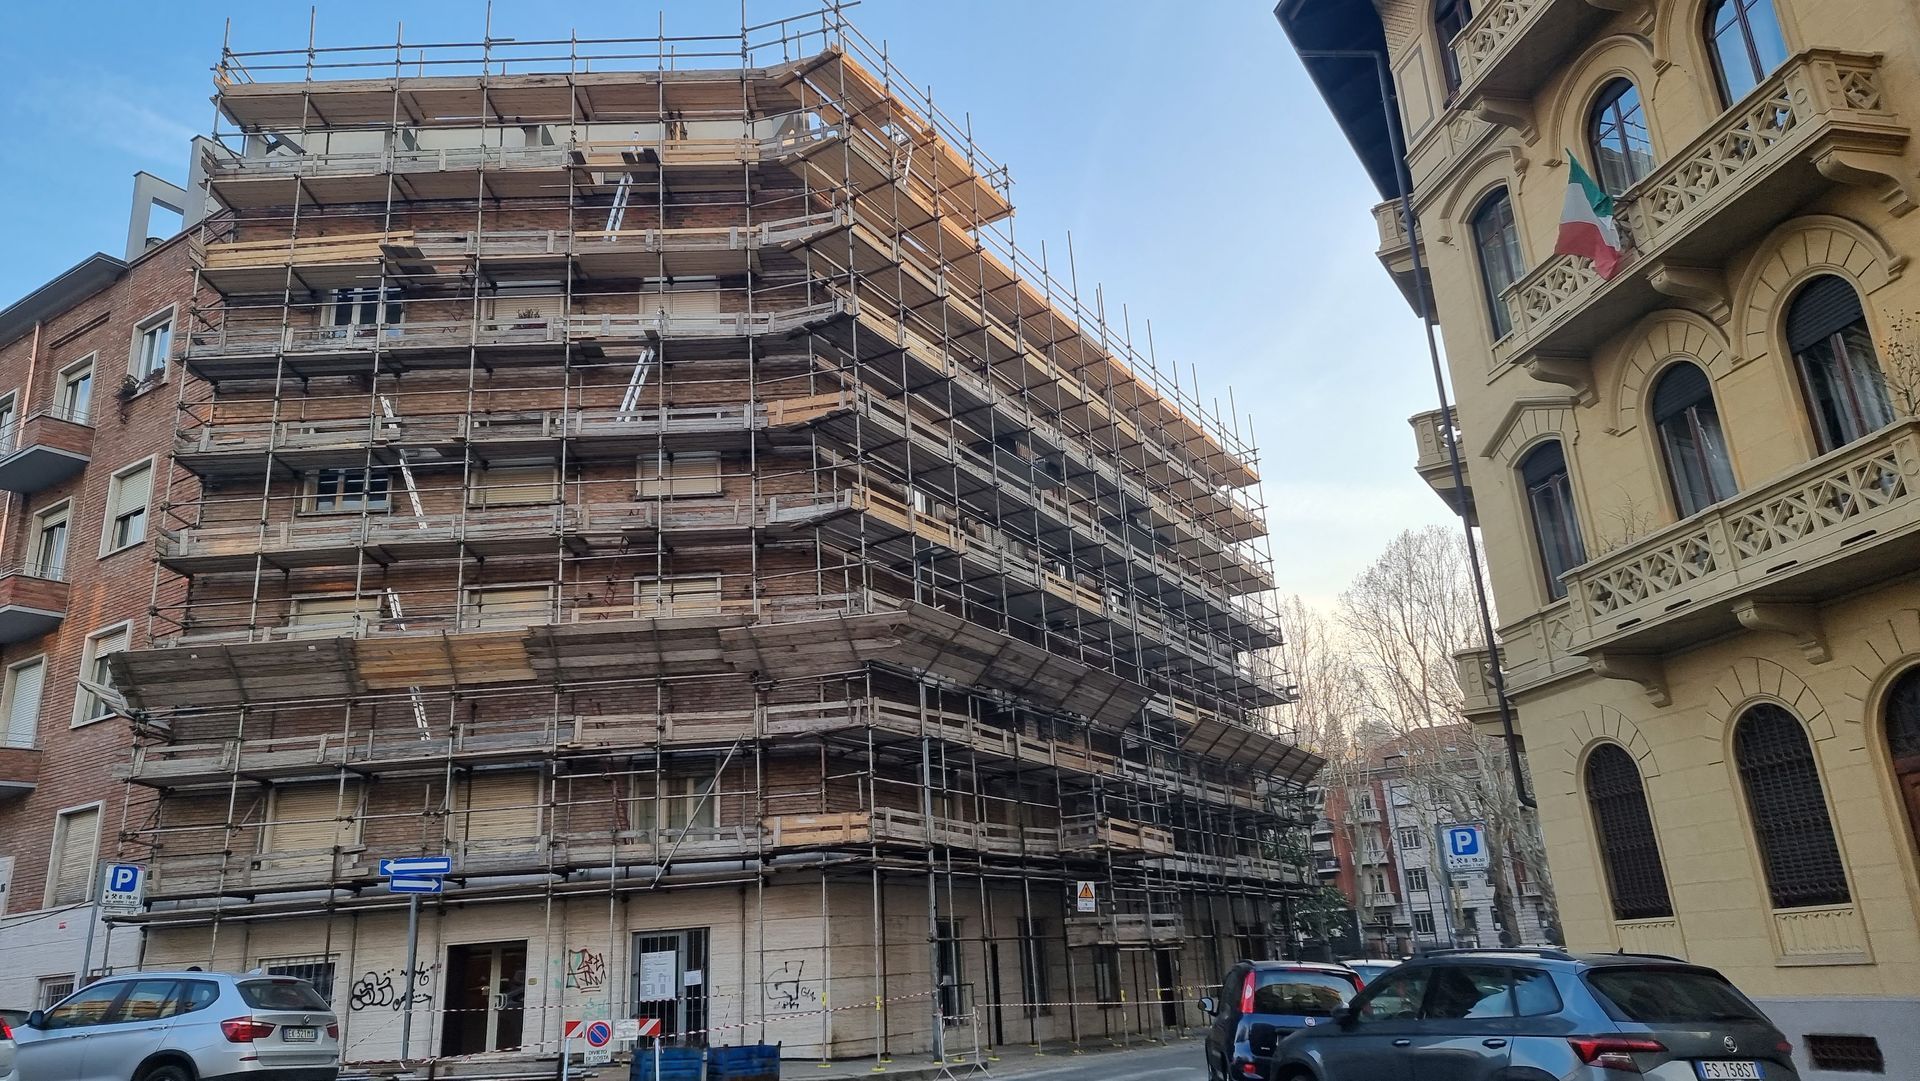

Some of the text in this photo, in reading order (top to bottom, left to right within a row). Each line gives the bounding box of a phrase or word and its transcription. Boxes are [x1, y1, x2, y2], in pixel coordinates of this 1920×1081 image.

[1455, 831, 1472, 853] P
[115, 868, 133, 889] P
[1704, 1062, 1757, 1078] FS 158ST
